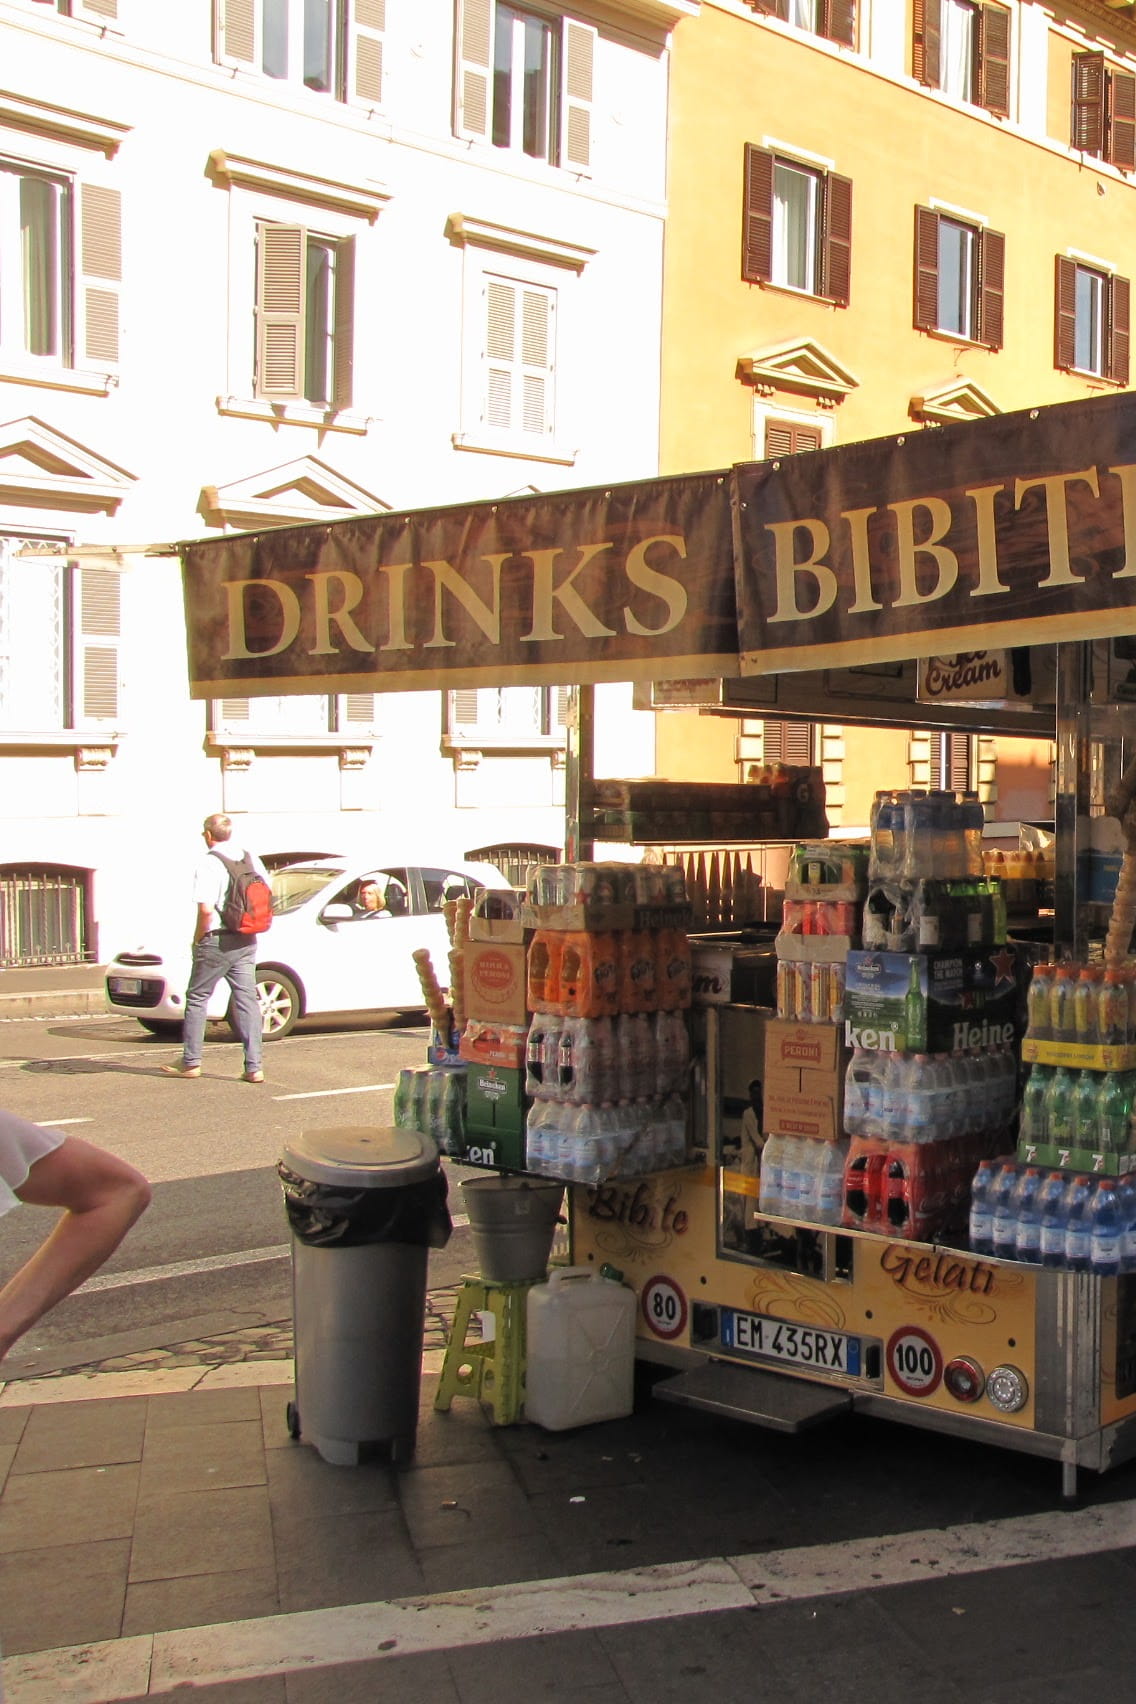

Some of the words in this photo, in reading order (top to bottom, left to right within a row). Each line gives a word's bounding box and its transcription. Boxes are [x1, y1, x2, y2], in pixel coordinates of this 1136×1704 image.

[219, 534, 688, 661] DRINKS
[925, 660, 1001, 696] Cream
[933, 959, 963, 968] CHAMPION
[934, 969, 943, 978] THE
[784, 1045, 818, 1057] PERONI
[845, 1020, 897, 1052] ken
[953, 1019, 1015, 1051] Heine
[479, 1078, 506, 1092] Heineken
[880, 1244, 994, 1293] Gelati
[652, 1292, 677, 1321] 80
[737, 1316, 763, 1350] EM
[772, 1325, 843, 1368] 435RX
[896, 1343, 933, 1376] 100
